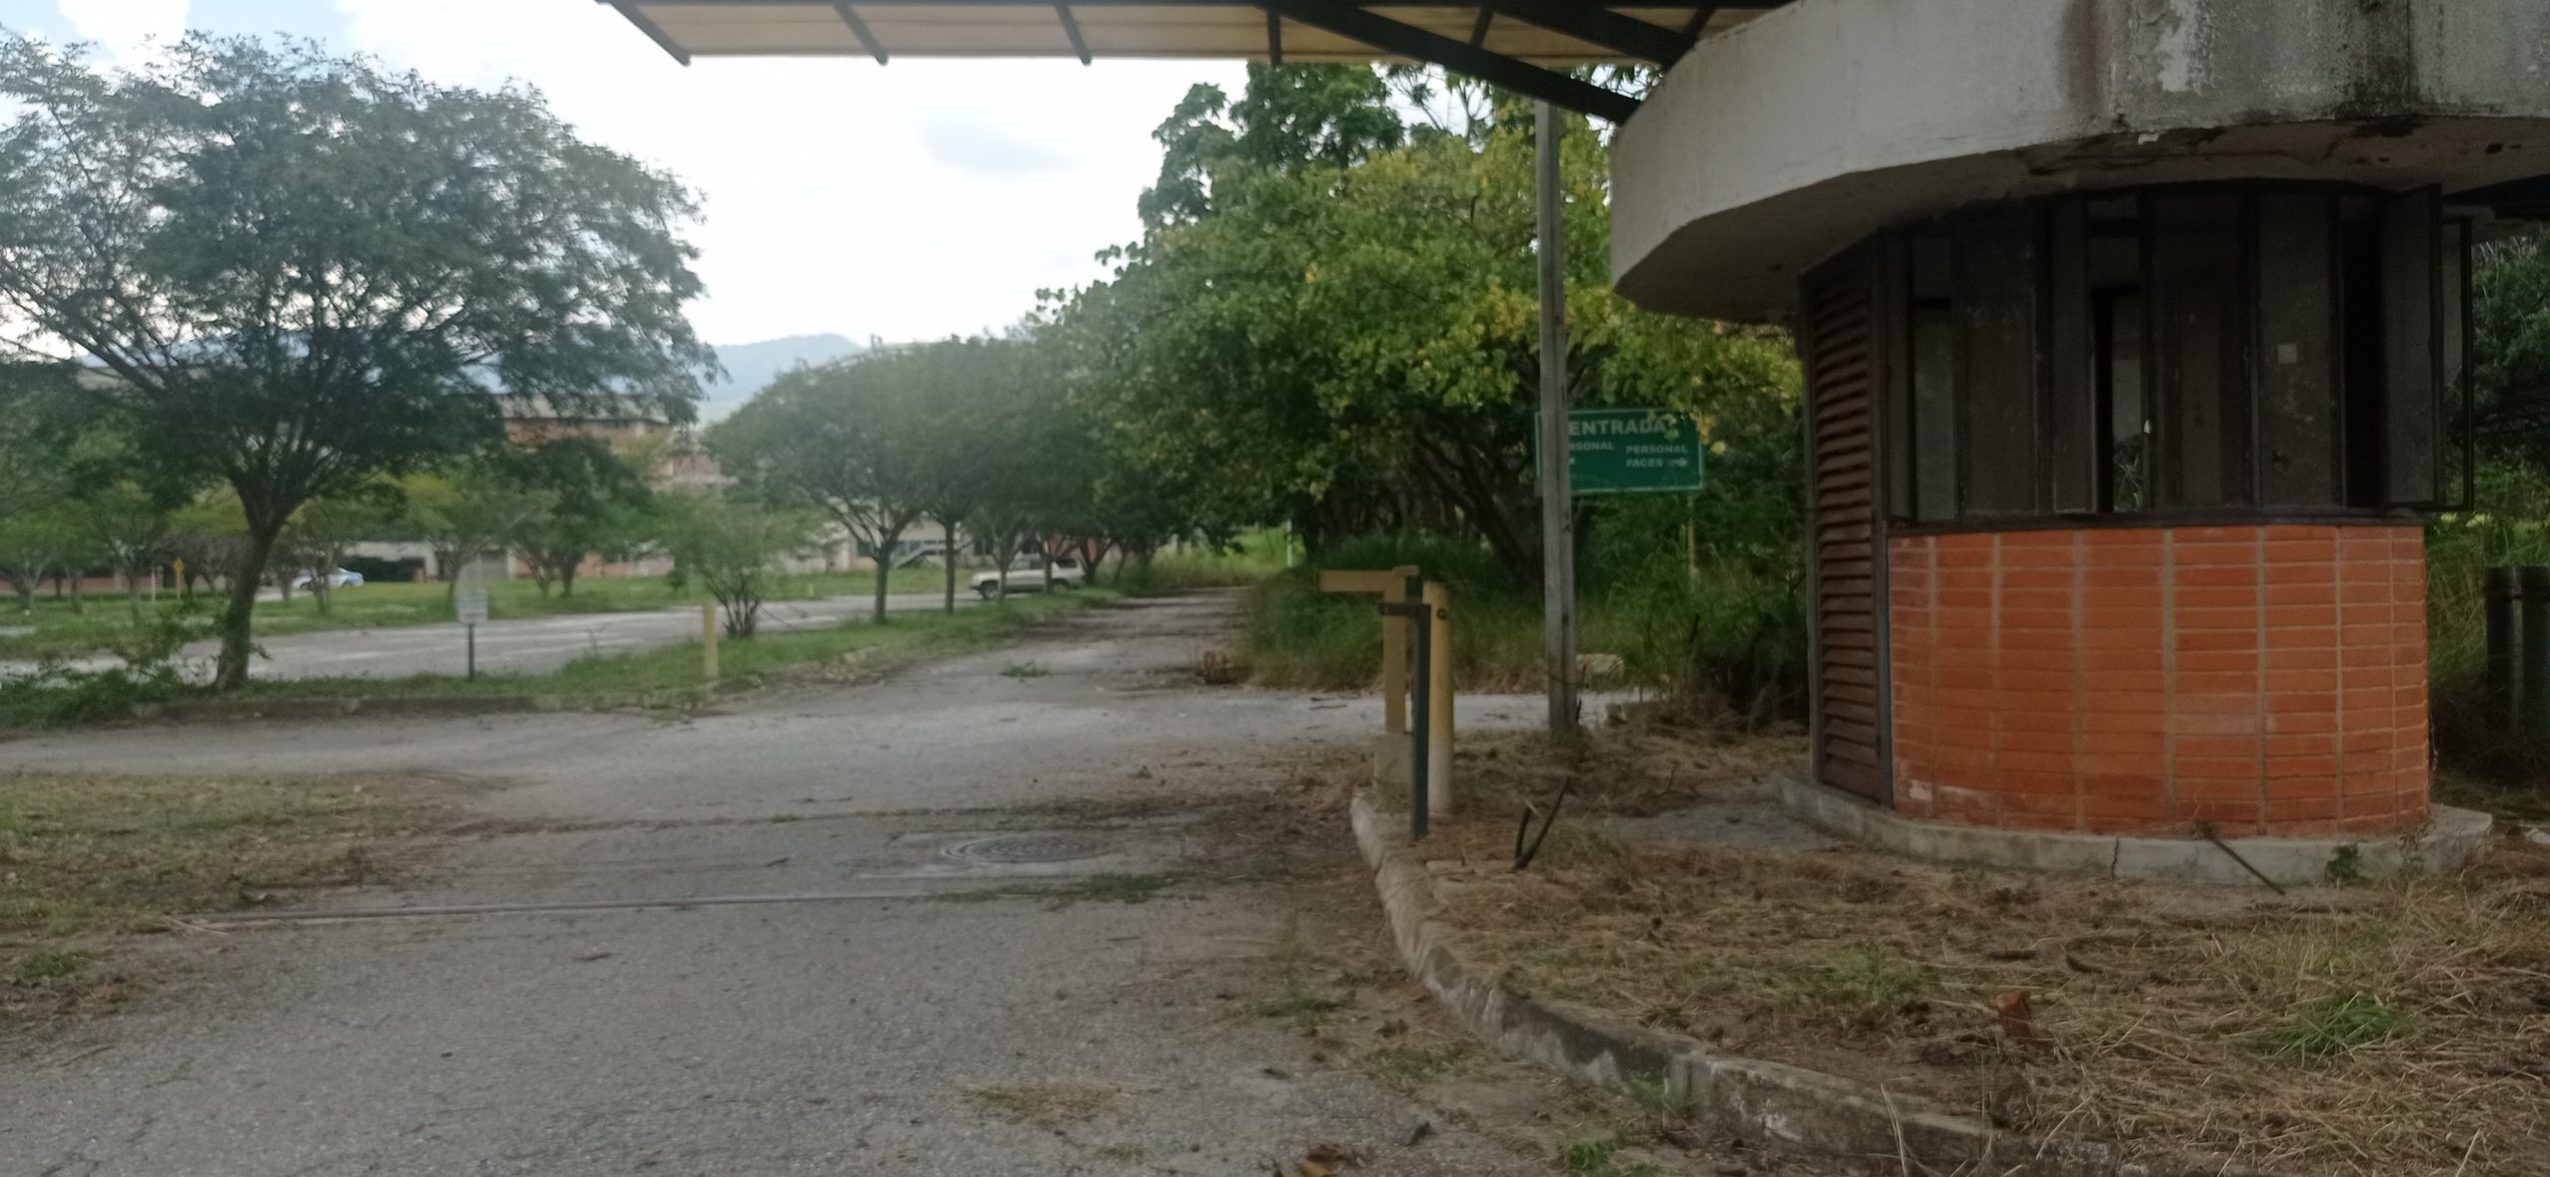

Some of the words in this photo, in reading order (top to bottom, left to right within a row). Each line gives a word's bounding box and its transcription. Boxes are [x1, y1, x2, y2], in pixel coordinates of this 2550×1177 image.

[1568, 418, 1667, 436] ENTRADA
[1568, 441, 1615, 451] RSONAL
[1626, 444, 1688, 454] PERSONAL
[1626, 457, 1664, 468] FACES
